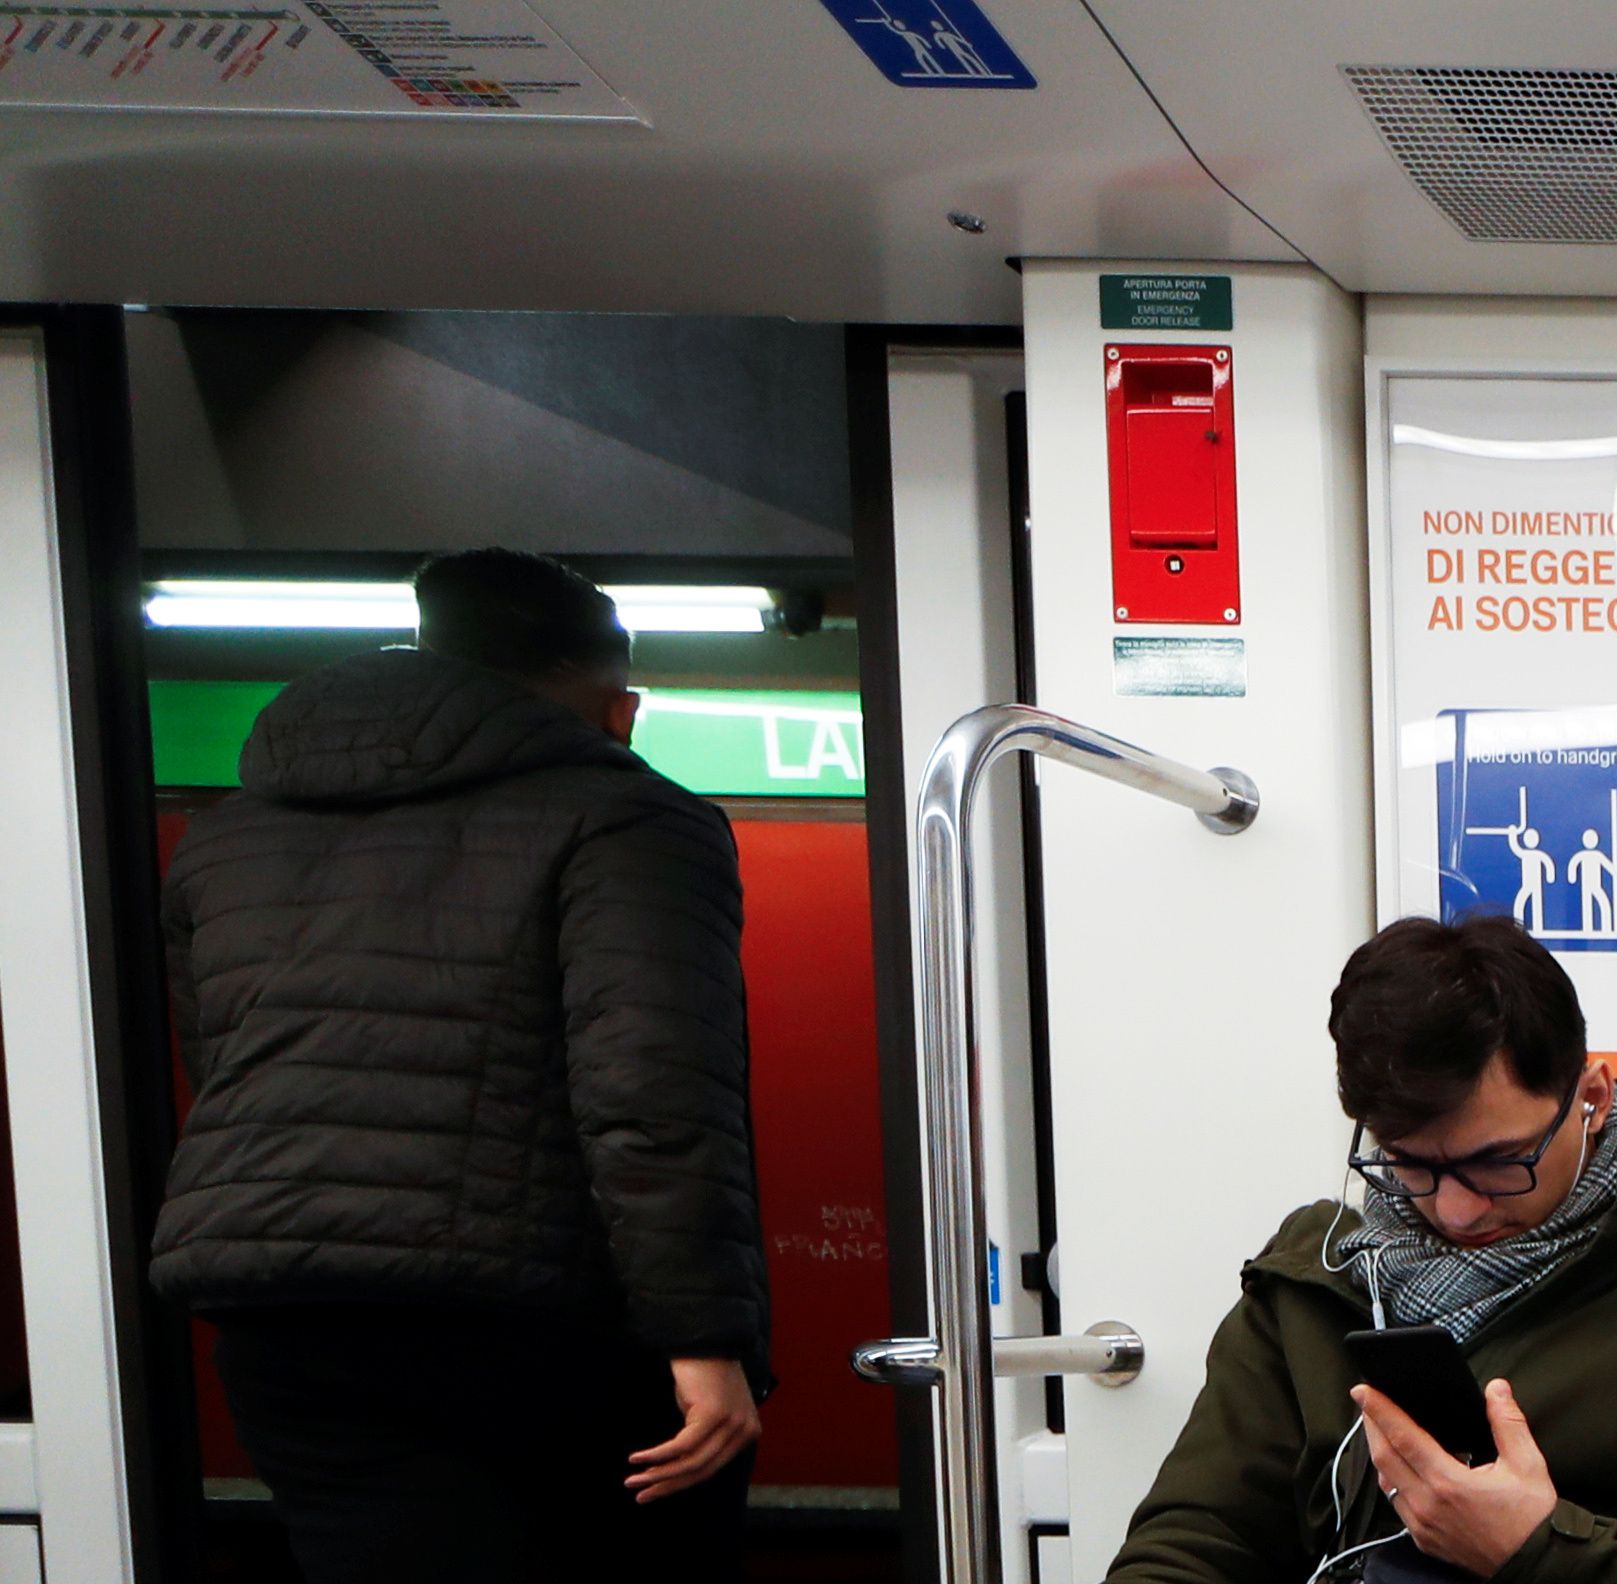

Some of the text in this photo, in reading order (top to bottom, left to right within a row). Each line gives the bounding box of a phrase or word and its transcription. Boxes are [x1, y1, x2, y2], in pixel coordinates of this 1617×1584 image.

[1123, 280, 1208, 290] APERTURA PORTA
[1130, 291, 1200, 301] IN EMERGENZA
[1137, 305, 1194, 315] EMERGENCY
[1131, 316, 1201, 327] DOOR RELEASE
[1423, 510, 1484, 535] NON
[1427, 549, 1464, 584] DI
[1427, 595, 1464, 631] AI
[1511, 751, 1532, 765] on
[1536, 749, 1552, 765] to
